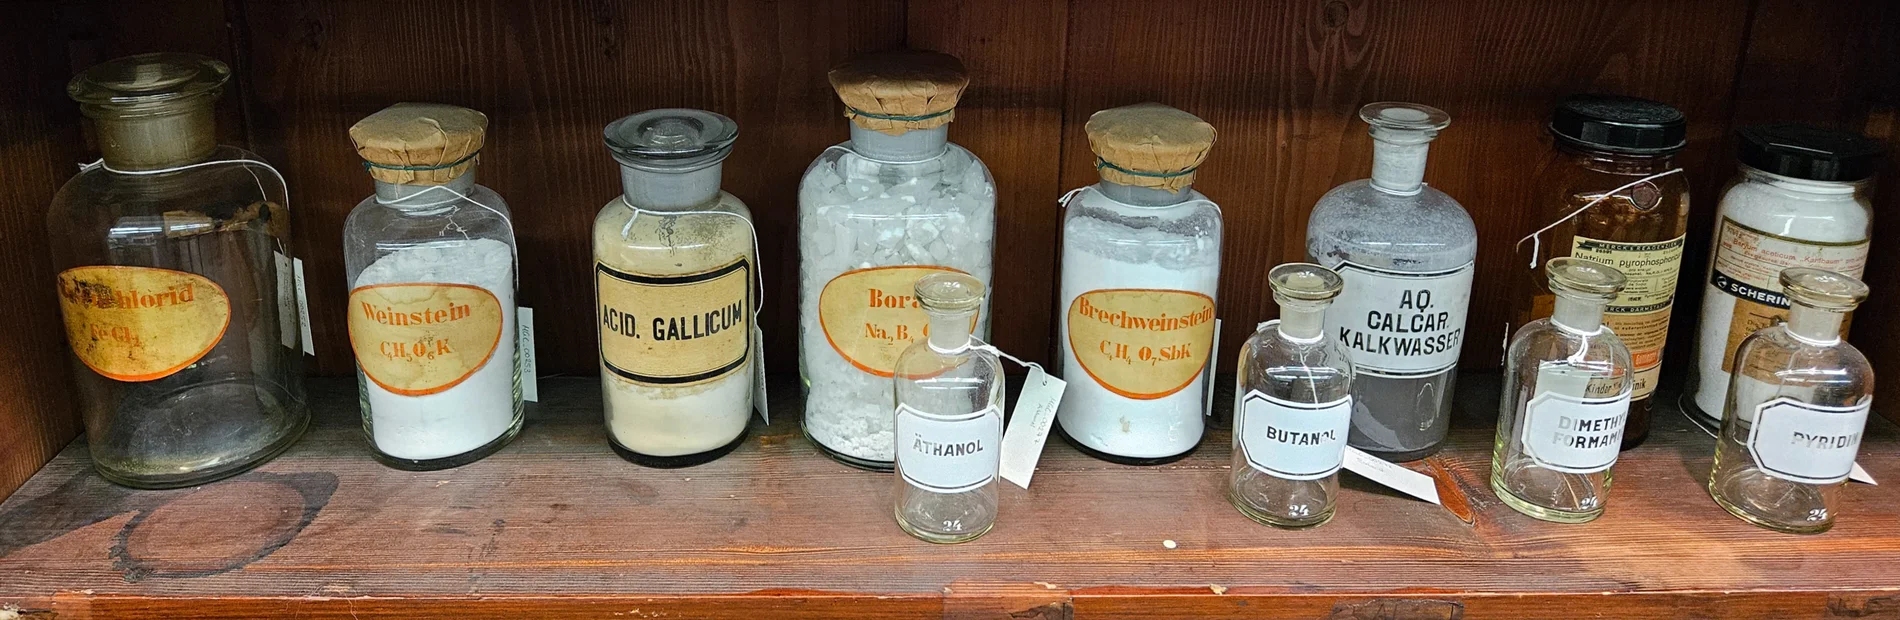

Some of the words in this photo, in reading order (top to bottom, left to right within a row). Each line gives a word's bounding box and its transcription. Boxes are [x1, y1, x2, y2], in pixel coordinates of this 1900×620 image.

[1574, 251, 1614, 265] Natrium
[867, 287, 920, 309] Bora
[1398, 289, 1435, 313] AQ.
[1730, 283, 1792, 307] SCHERIN
[360, 300, 471, 327] Weinstein
[603, 304, 641, 339] ACID.
[652, 299, 742, 341] GALLICUM
[1078, 296, 1212, 332] Brechweinstein
[1367, 310, 1450, 333] CALCAR.
[1339, 327, 1461, 356] KALKWASSER
[912, 432, 984, 457] ÄTHANOL
[1552, 429, 1622, 449] FORMAMI
[1288, 503, 1310, 517] 24
[942, 519, 963, 532] 24
